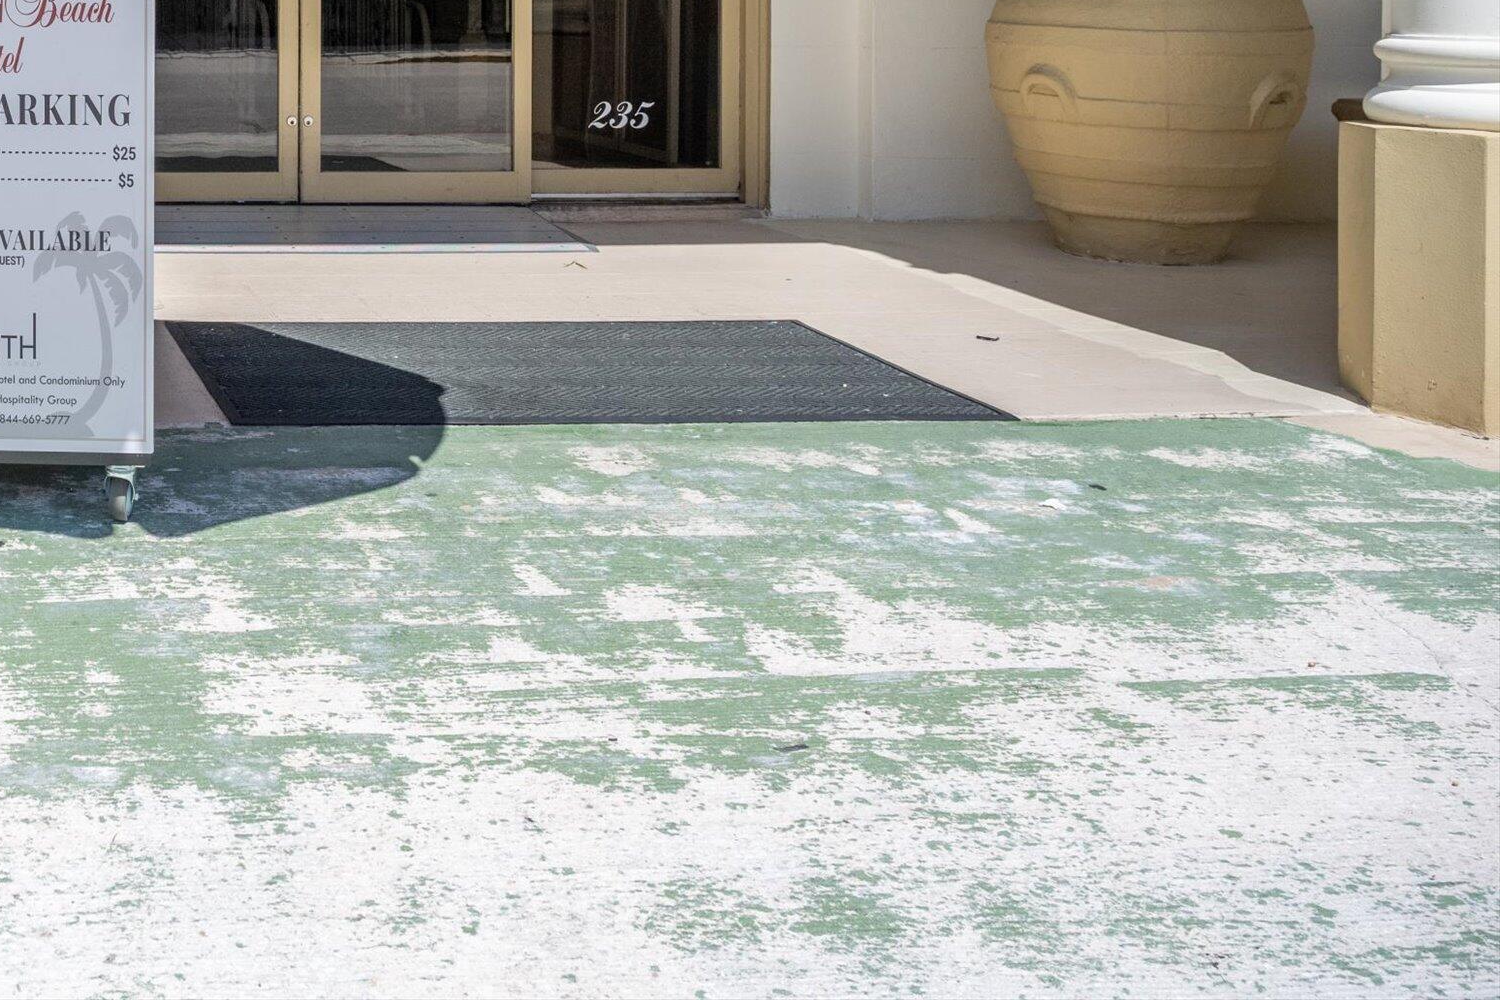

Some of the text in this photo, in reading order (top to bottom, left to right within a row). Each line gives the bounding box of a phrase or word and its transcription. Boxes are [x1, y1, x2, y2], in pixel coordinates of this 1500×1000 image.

[588, 101, 655, 129] 235
[113, 146, 136, 161] $25
[118, 173, 134, 188] $5
[18, 374, 36, 385] and
[39, 375, 100, 386] Condominium
[103, 376, 125, 388] Only
[47, 395, 77, 406] Group
[0, 414, 70, 425] 844-669-5777
